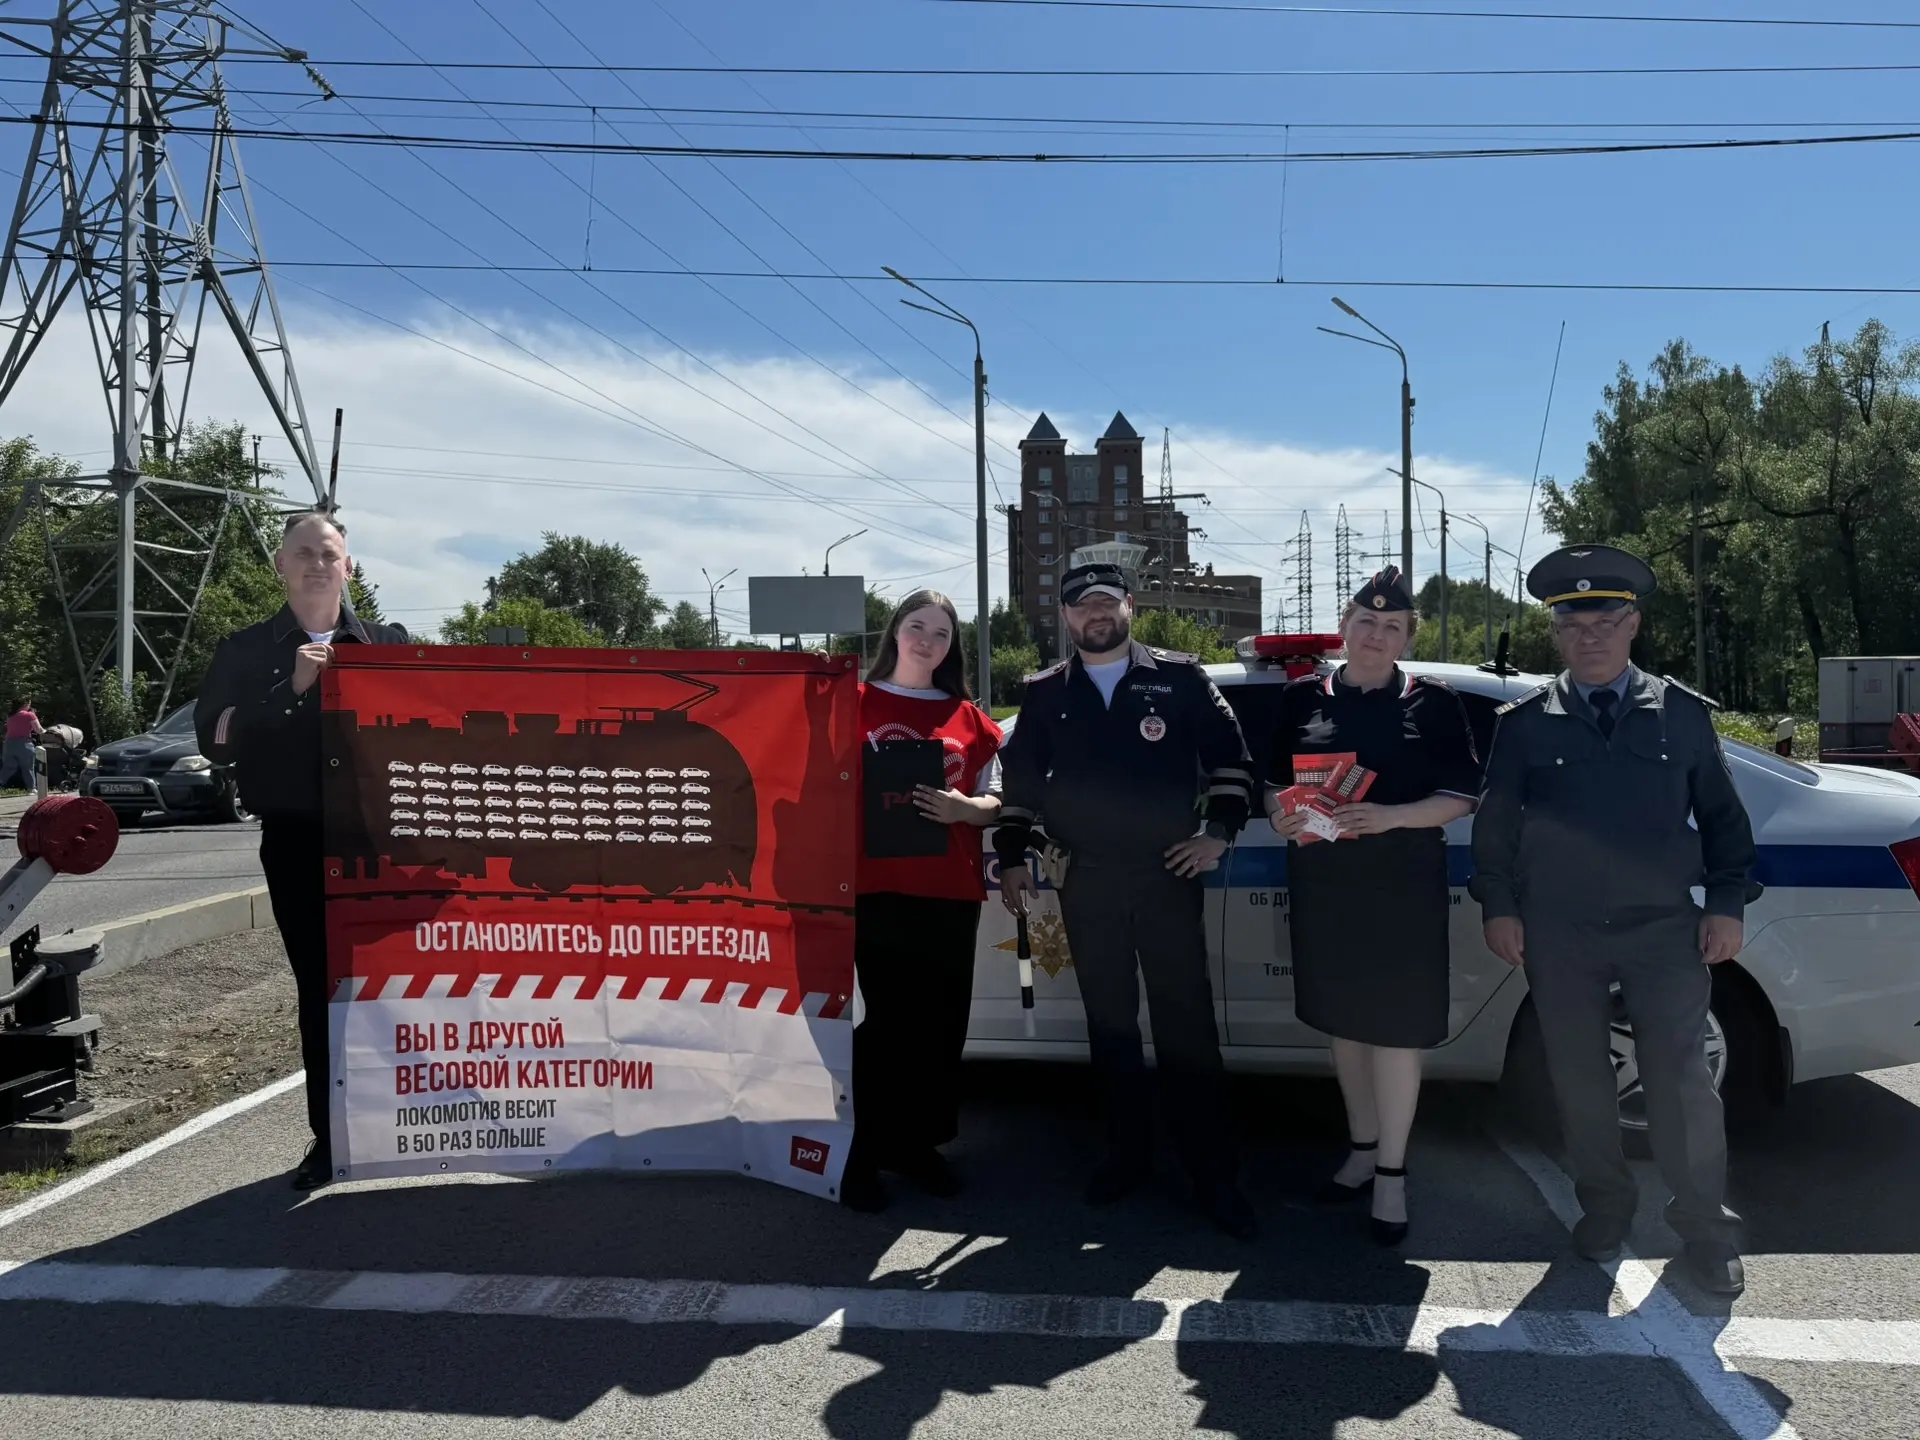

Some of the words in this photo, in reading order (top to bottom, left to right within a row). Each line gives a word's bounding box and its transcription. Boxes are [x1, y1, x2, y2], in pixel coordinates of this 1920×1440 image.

[415, 921, 602, 954] ОСТАНОВИТЕСЬ
[609, 924, 642, 957] ДО
[649, 926, 771, 963] ПЕРЕЕЗДА
[395, 1022, 436, 1053] ВЫ
[443, 1021, 460, 1052] В
[466, 1016, 564, 1055] ДРУГОЙ
[395, 1055, 509, 1095] ВЕСОВОЙ
[517, 1057, 654, 1091] КАТЕГОРИИ
[395, 1099, 501, 1128] ЛОКОМОТИВ
[506, 1098, 557, 1121] ВЕСИТ
[397, 1134, 408, 1154] В
[412, 1133, 436, 1153] 50
[439, 1130, 472, 1151] РАЗ
[476, 1126, 546, 1149] БОЛЬШЕ
